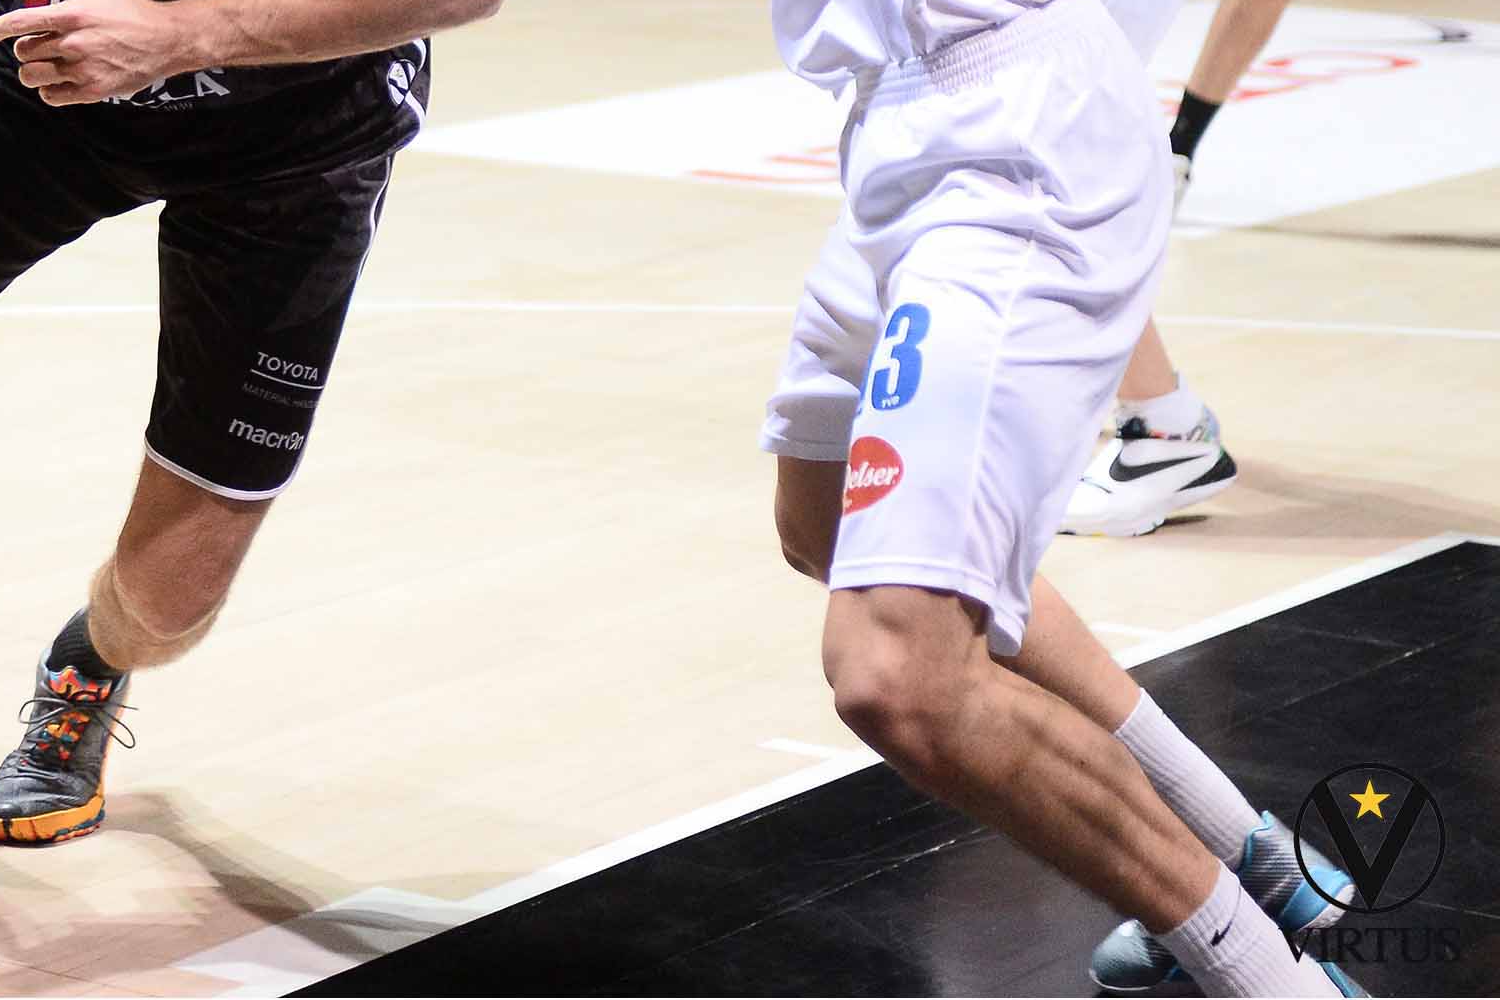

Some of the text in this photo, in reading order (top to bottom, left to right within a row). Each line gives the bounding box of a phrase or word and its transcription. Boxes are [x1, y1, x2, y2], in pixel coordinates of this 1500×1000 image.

[257, 351, 319, 381] TOYOTA
[856, 302, 931, 415] 3
[228, 418, 305, 451] macron
